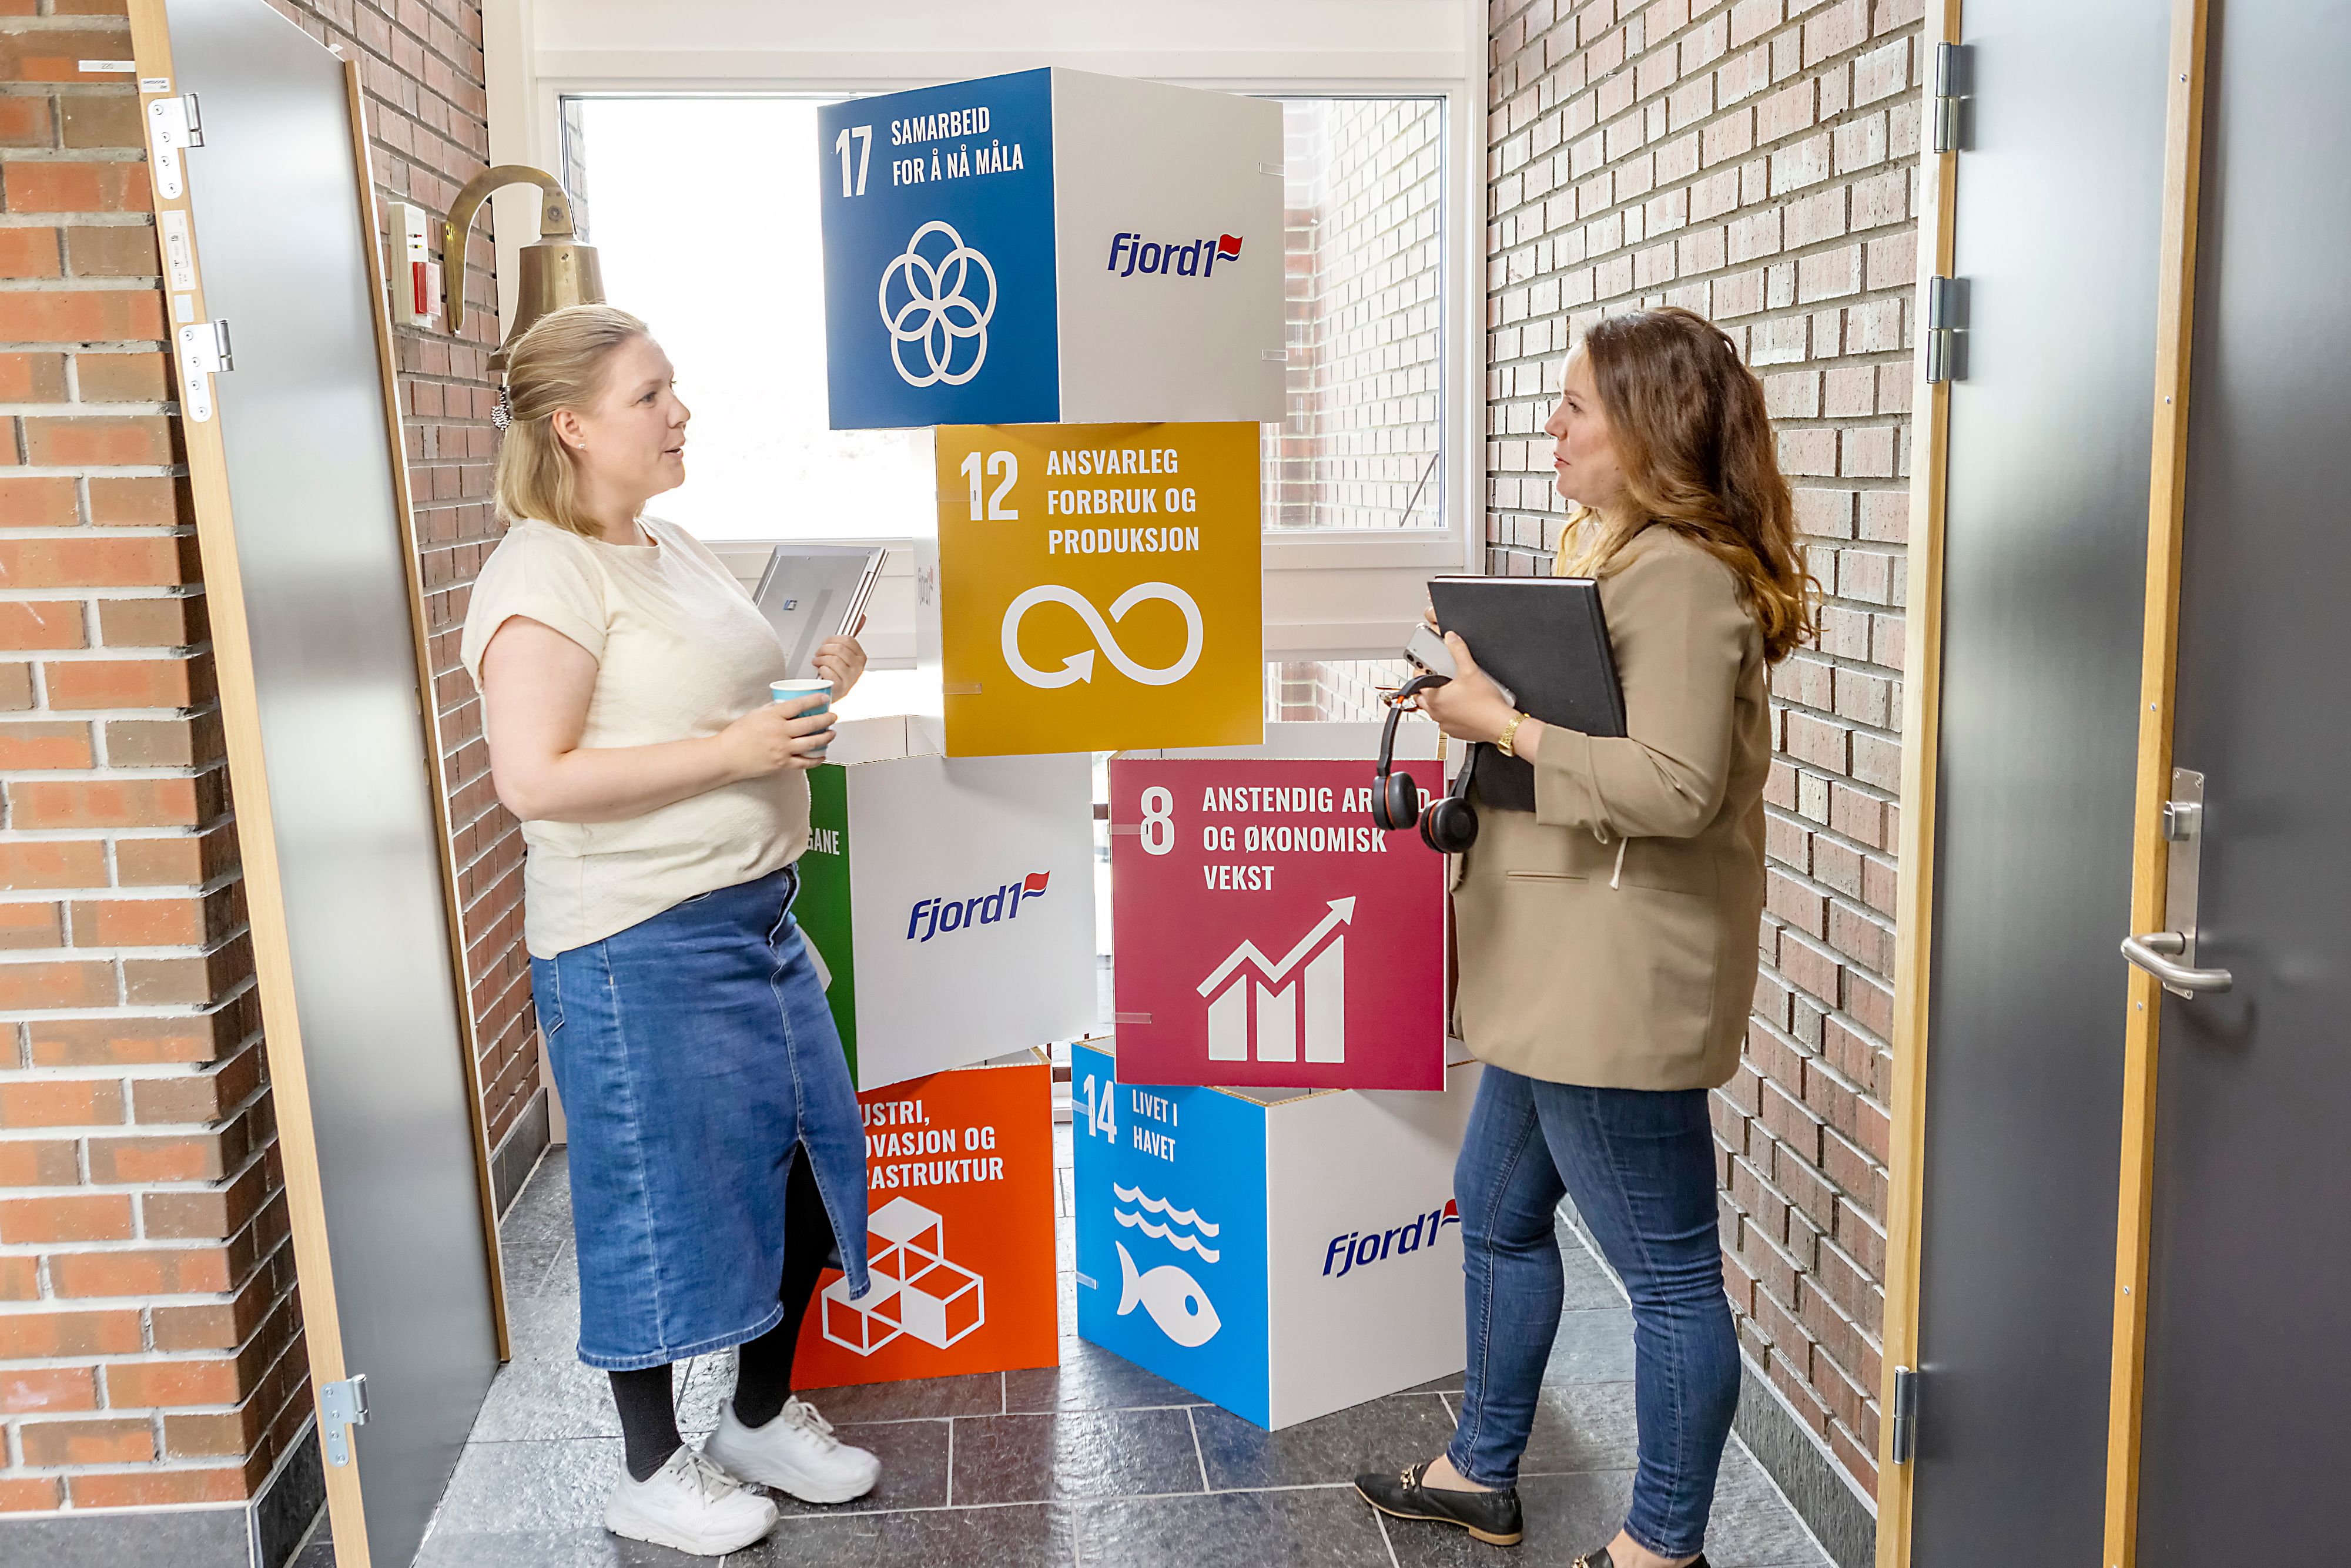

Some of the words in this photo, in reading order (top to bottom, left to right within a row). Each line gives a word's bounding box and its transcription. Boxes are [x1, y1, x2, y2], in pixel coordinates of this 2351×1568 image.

[891, 106, 990, 146] SAMARBEID
[835, 125, 872, 198] 17
[893, 158, 925, 186] FOR
[930, 148, 942, 182] Å
[947, 143, 970, 179] NÅ
[976, 139, 1024, 175] MÅLA
[1108, 233, 1217, 277] Fjord1
[1046, 448, 1178, 475] ANSVARLEG
[960, 451, 1019, 521] 12
[1048, 488, 1157, 515] FORBRUK
[1165, 487, 1195, 512] OG
[1049, 527, 1199, 554] PRODUKSJON
[1202, 787, 1333, 813] ANSTENDIG
[1341, 788, 1431, 813] ARD
[1140, 786, 1175, 856] 8
[1203, 826, 1235, 851] OG
[1244, 825, 1387, 853] ØKONOMISK
[808, 827, 840, 855] GANE
[1203, 865, 1275, 890] VEKST
[907, 882, 1023, 943] Fjord1
[858, 1100, 930, 1127] USTRI,
[1083, 1073, 1117, 1144] 14
[1133, 1089, 1168, 1123] LIVET
[1173, 1103, 1178, 1127] I
[866, 1128, 956, 1158] VASJON
[964, 1126, 995, 1151] OG
[1133, 1125, 1176, 1162] HAVET
[867, 1157, 1004, 1190] ASTRUKTUR
[1322, 1209, 1442, 1278] Fjord1
